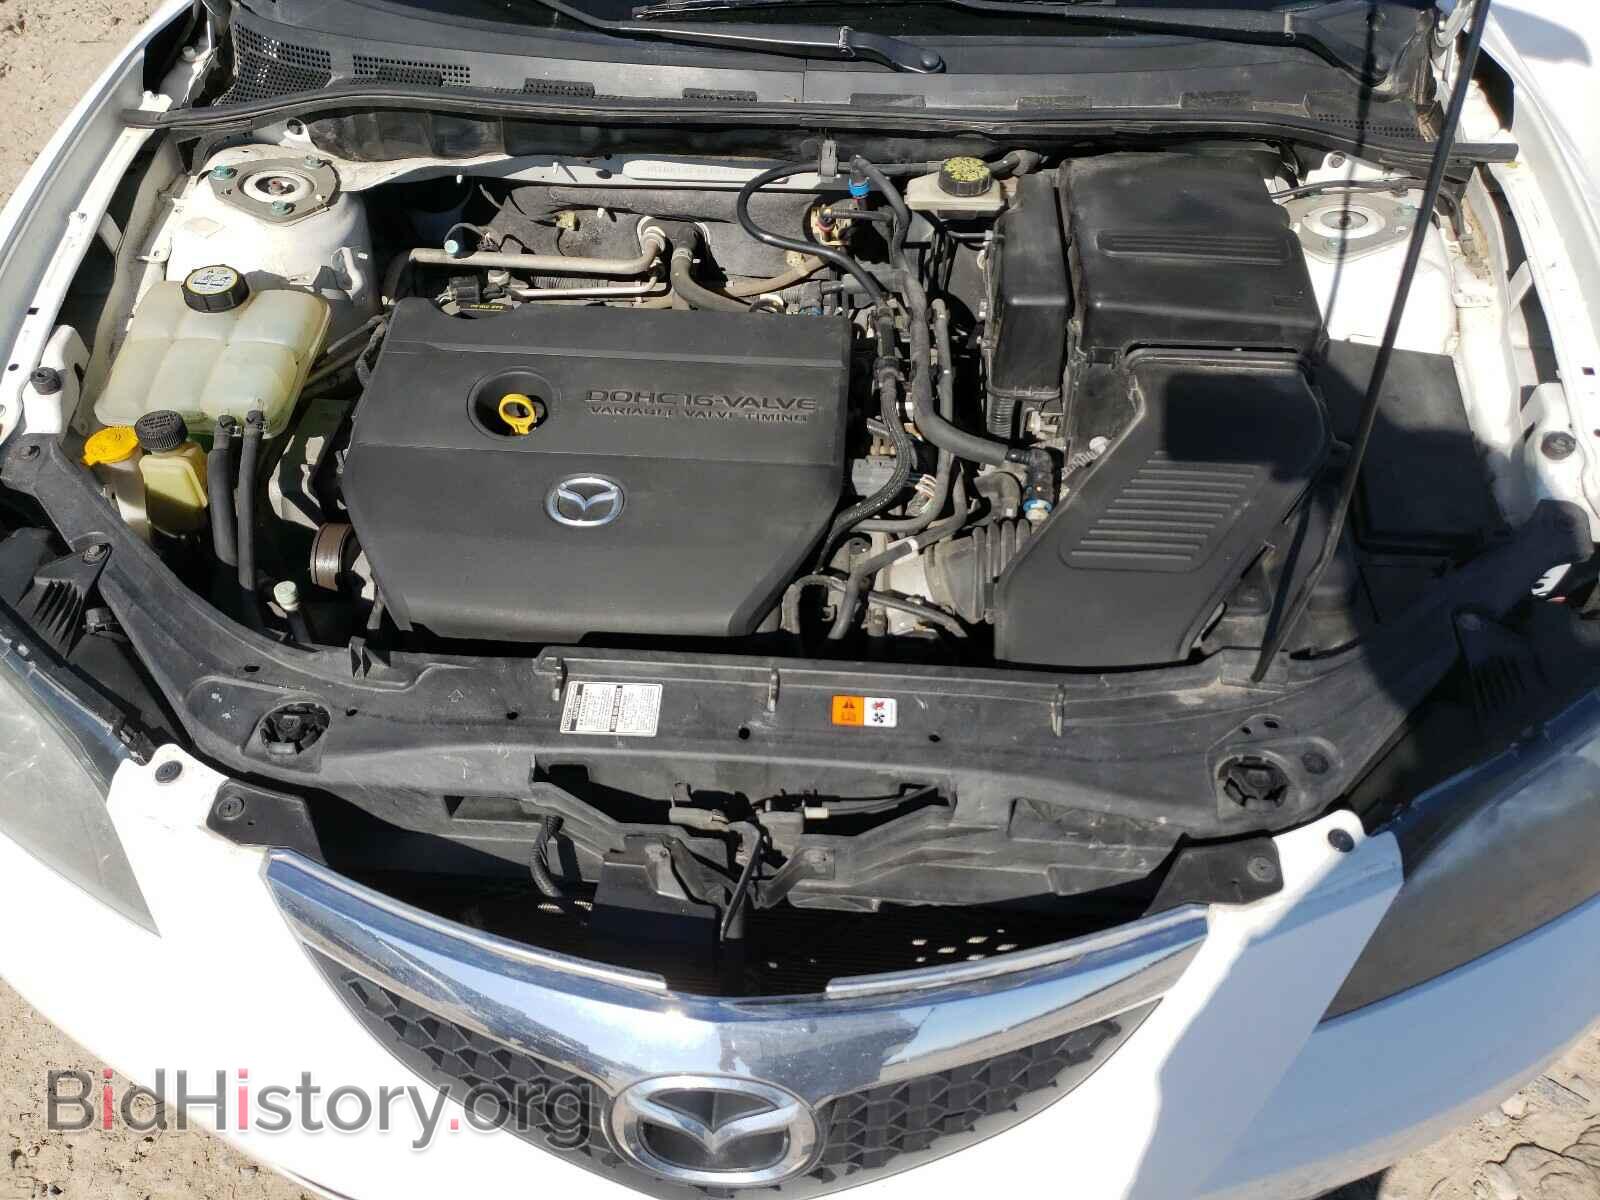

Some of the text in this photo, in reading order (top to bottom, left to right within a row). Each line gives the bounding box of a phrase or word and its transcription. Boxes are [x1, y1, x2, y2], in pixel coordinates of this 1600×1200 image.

[584, 390, 817, 410] DOHC 16-VALVE
[745, 412, 808, 423] TIMING
